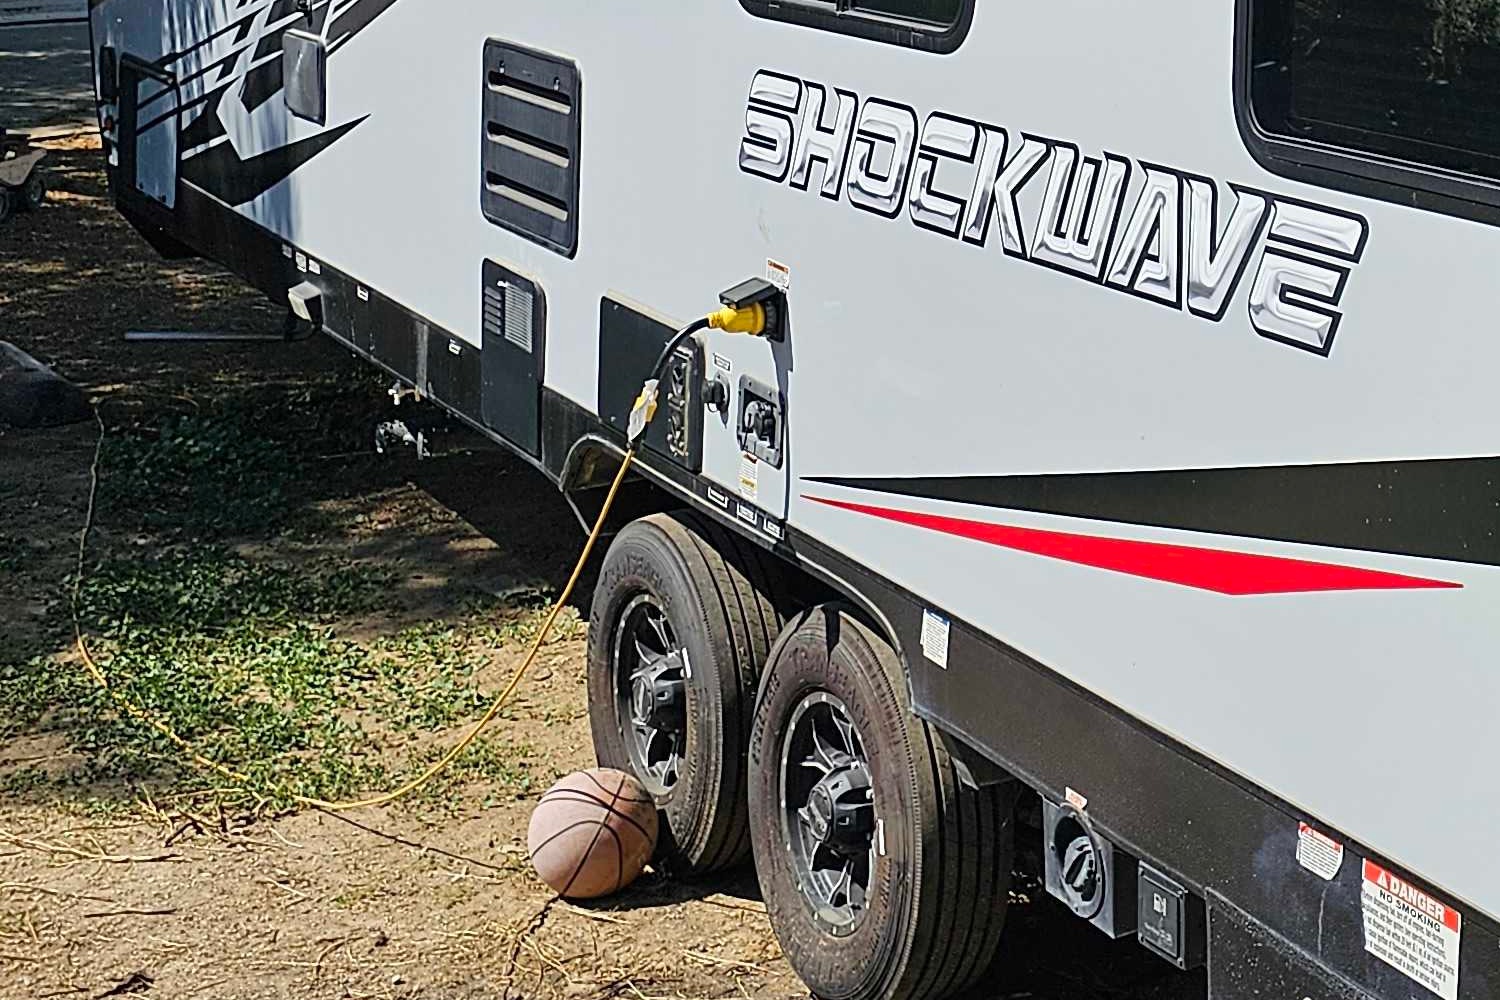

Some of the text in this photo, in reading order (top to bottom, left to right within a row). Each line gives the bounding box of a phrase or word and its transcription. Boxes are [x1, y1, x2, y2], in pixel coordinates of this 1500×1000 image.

[738, 68, 1370, 358] SHOCKWAVE
[1379, 889, 1441, 932] NO SMOKING
[1390, 873, 1445, 923] DANGER
